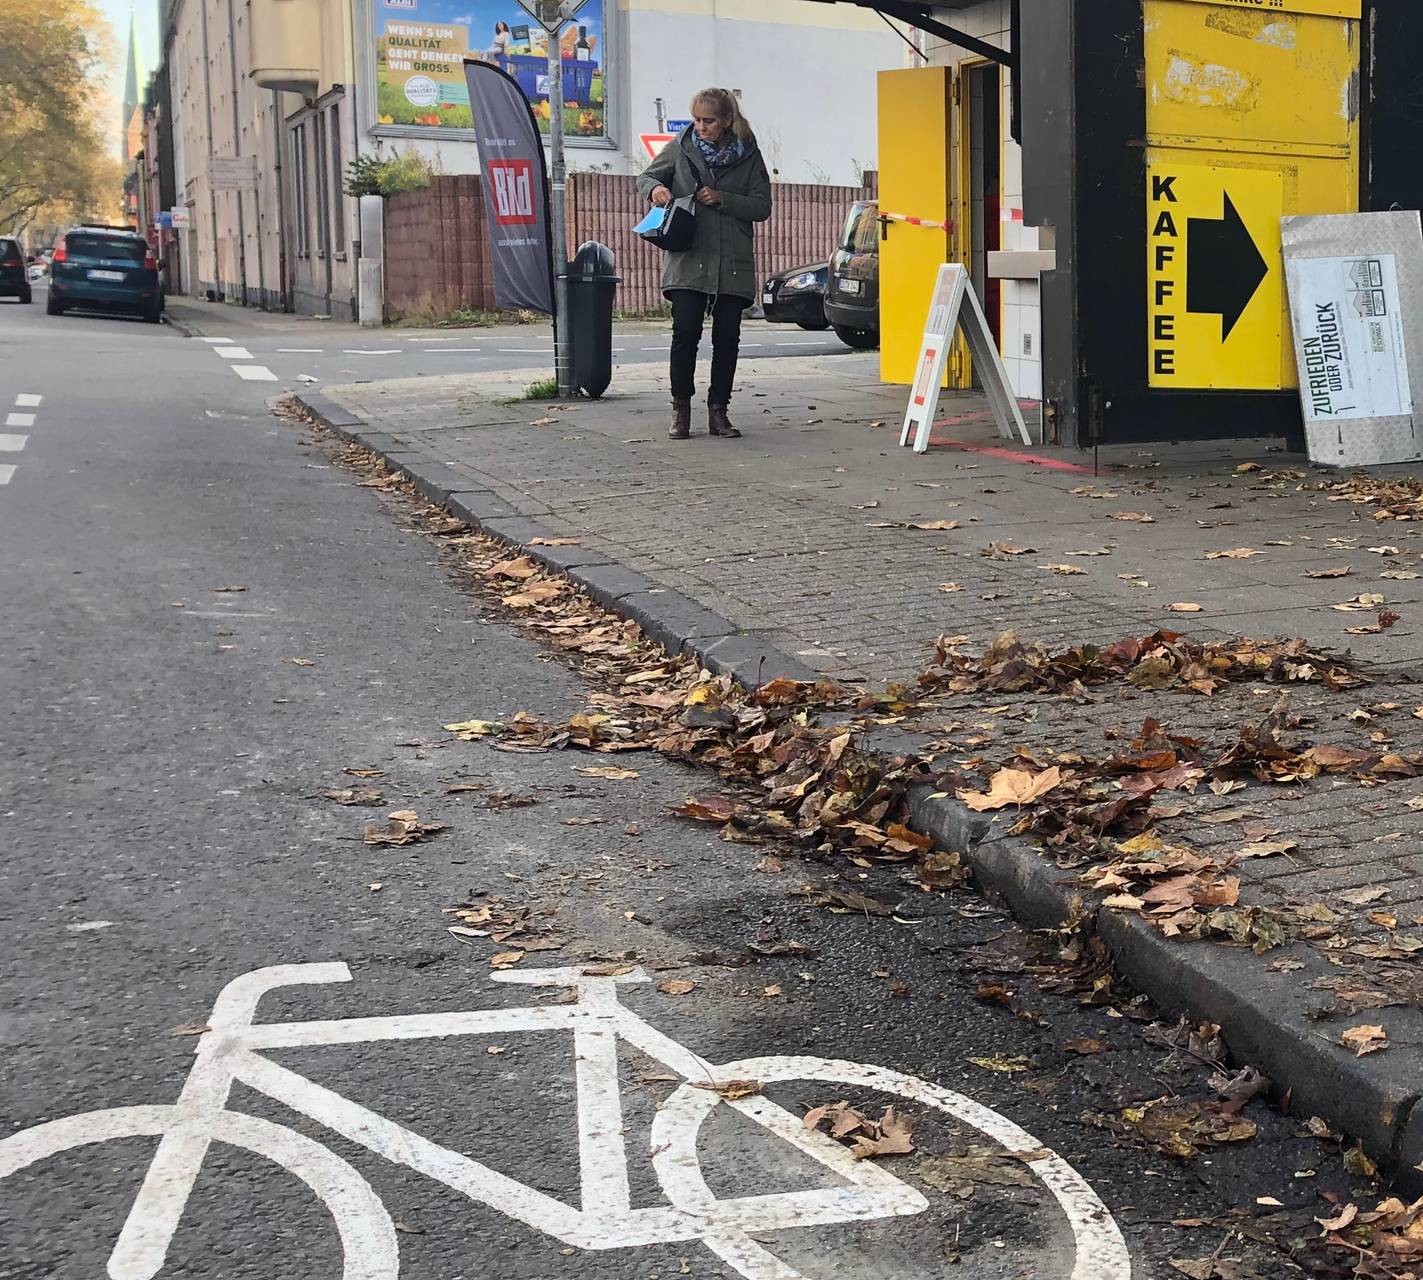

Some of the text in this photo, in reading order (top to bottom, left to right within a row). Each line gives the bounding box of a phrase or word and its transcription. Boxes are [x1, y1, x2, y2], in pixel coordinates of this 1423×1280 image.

[436, 29, 453, 39] UM
[388, 37, 442, 49] QUALITÄT
[388, 48, 465, 64] GEHT DENKEN
[388, 60, 411, 71] WIR
[1151, 174, 1179, 376] KAFFEE
[1315, 301, 1343, 393] ODER ZURÜCK
[1302, 337, 1333, 417] ZUFRIEDEN
